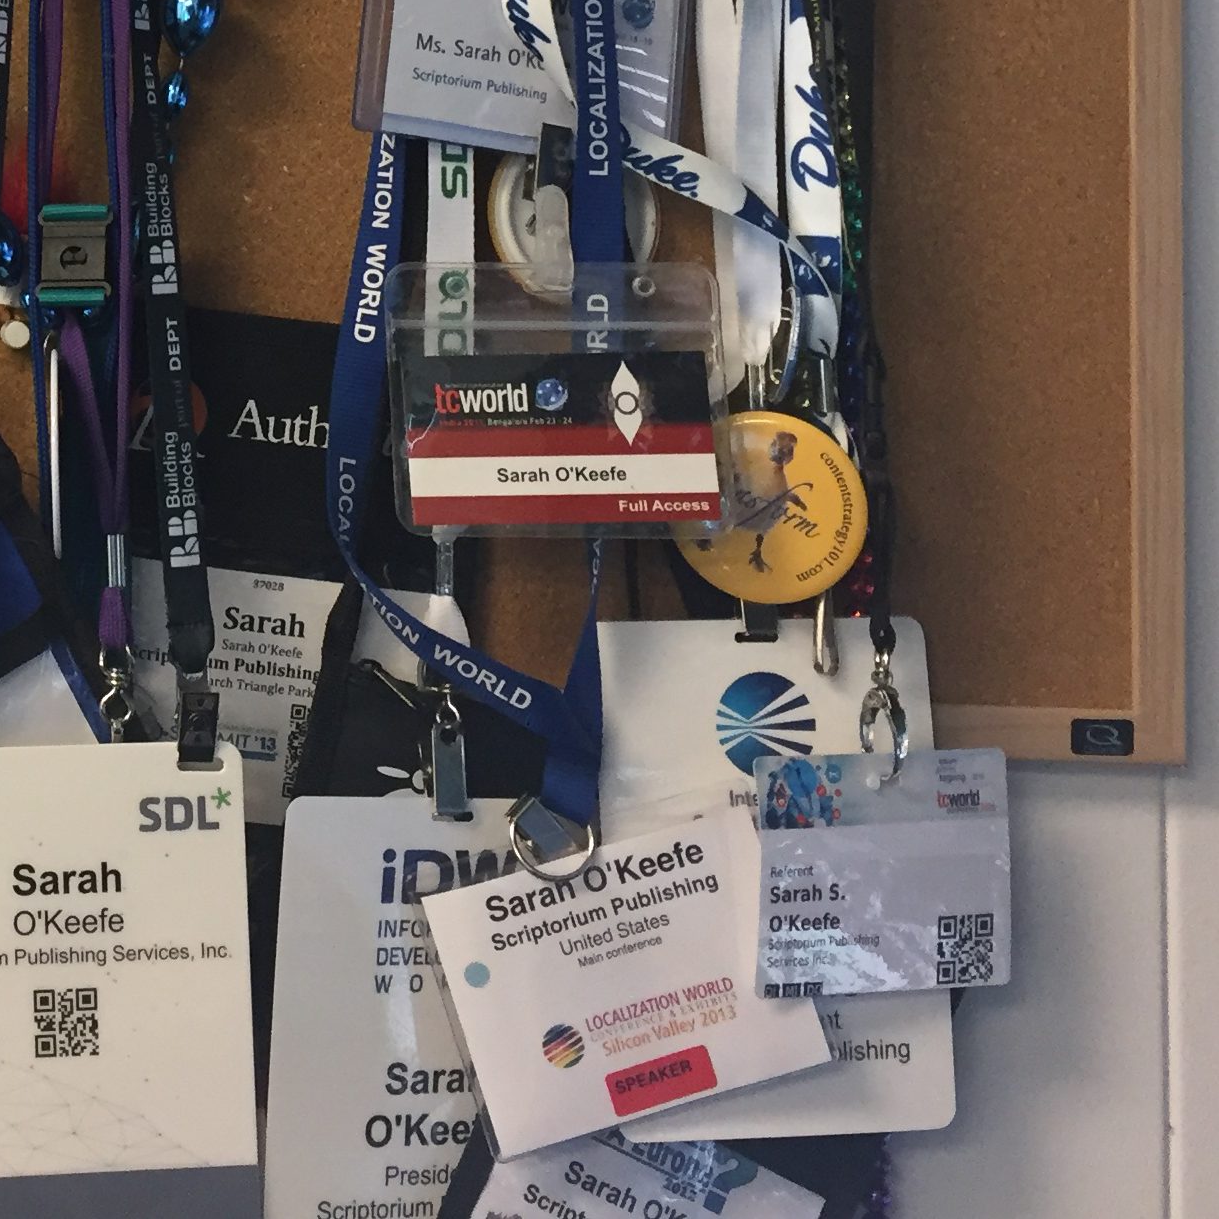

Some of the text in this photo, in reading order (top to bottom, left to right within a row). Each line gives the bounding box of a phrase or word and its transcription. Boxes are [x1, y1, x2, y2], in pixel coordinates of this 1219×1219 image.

[416, 33, 501, 63] Ms. Sarah
[145, 52, 158, 105] DEPT
[412, 67, 547, 103] Scriptorium Publishing
[146, 162, 159, 238] Building
[159, 172, 173, 238] Blocks
[353, 244, 388, 343] WORLD
[168, 317, 182, 372] DEPT
[434, 382, 529, 414] tcworld
[165, 431, 180, 510] Building
[180, 440, 194, 508] Blocks
[497, 467, 627, 483] Sarah O'Keefe
[618, 499, 710, 512] Full Access
[223, 607, 305, 638] Sarah
[221, 639, 303, 659] Sarah O'Keefe
[234, 658, 321, 685] Publishing
[237, 679, 285, 696] Triangle
[432, 644, 533, 711] WORLD
[937, 789, 981, 808] tcworld
[12, 861, 123, 897] Sarah
[485, 842, 705, 922] Sarah O'Keefe
[770, 865, 814, 878] Referent
[770, 883, 846, 904] Sarah S.
[13, 908, 125, 936] O'Keefe
[491, 872, 720, 952] Scriptorium Publishing
[769, 912, 841, 933] O'Keefe
[559, 913, 670, 957] United States
[577, 935, 663, 969] Main conference
[14, 947, 107, 966] Publishing
[112, 944, 195, 963] Services,
[201, 942, 233, 959] Inc.
[585, 977, 734, 1033] LOCALIZATION WORLD
[589, 1014, 665, 1042] CONFERENCE
[602, 1005, 738, 1058] Silicon Valley 2013
[614, 1058, 693, 1095] SPEAKER
[564, 1159, 639, 1209] Sarah
[317, 1199, 434, 1219] Scriptorium
